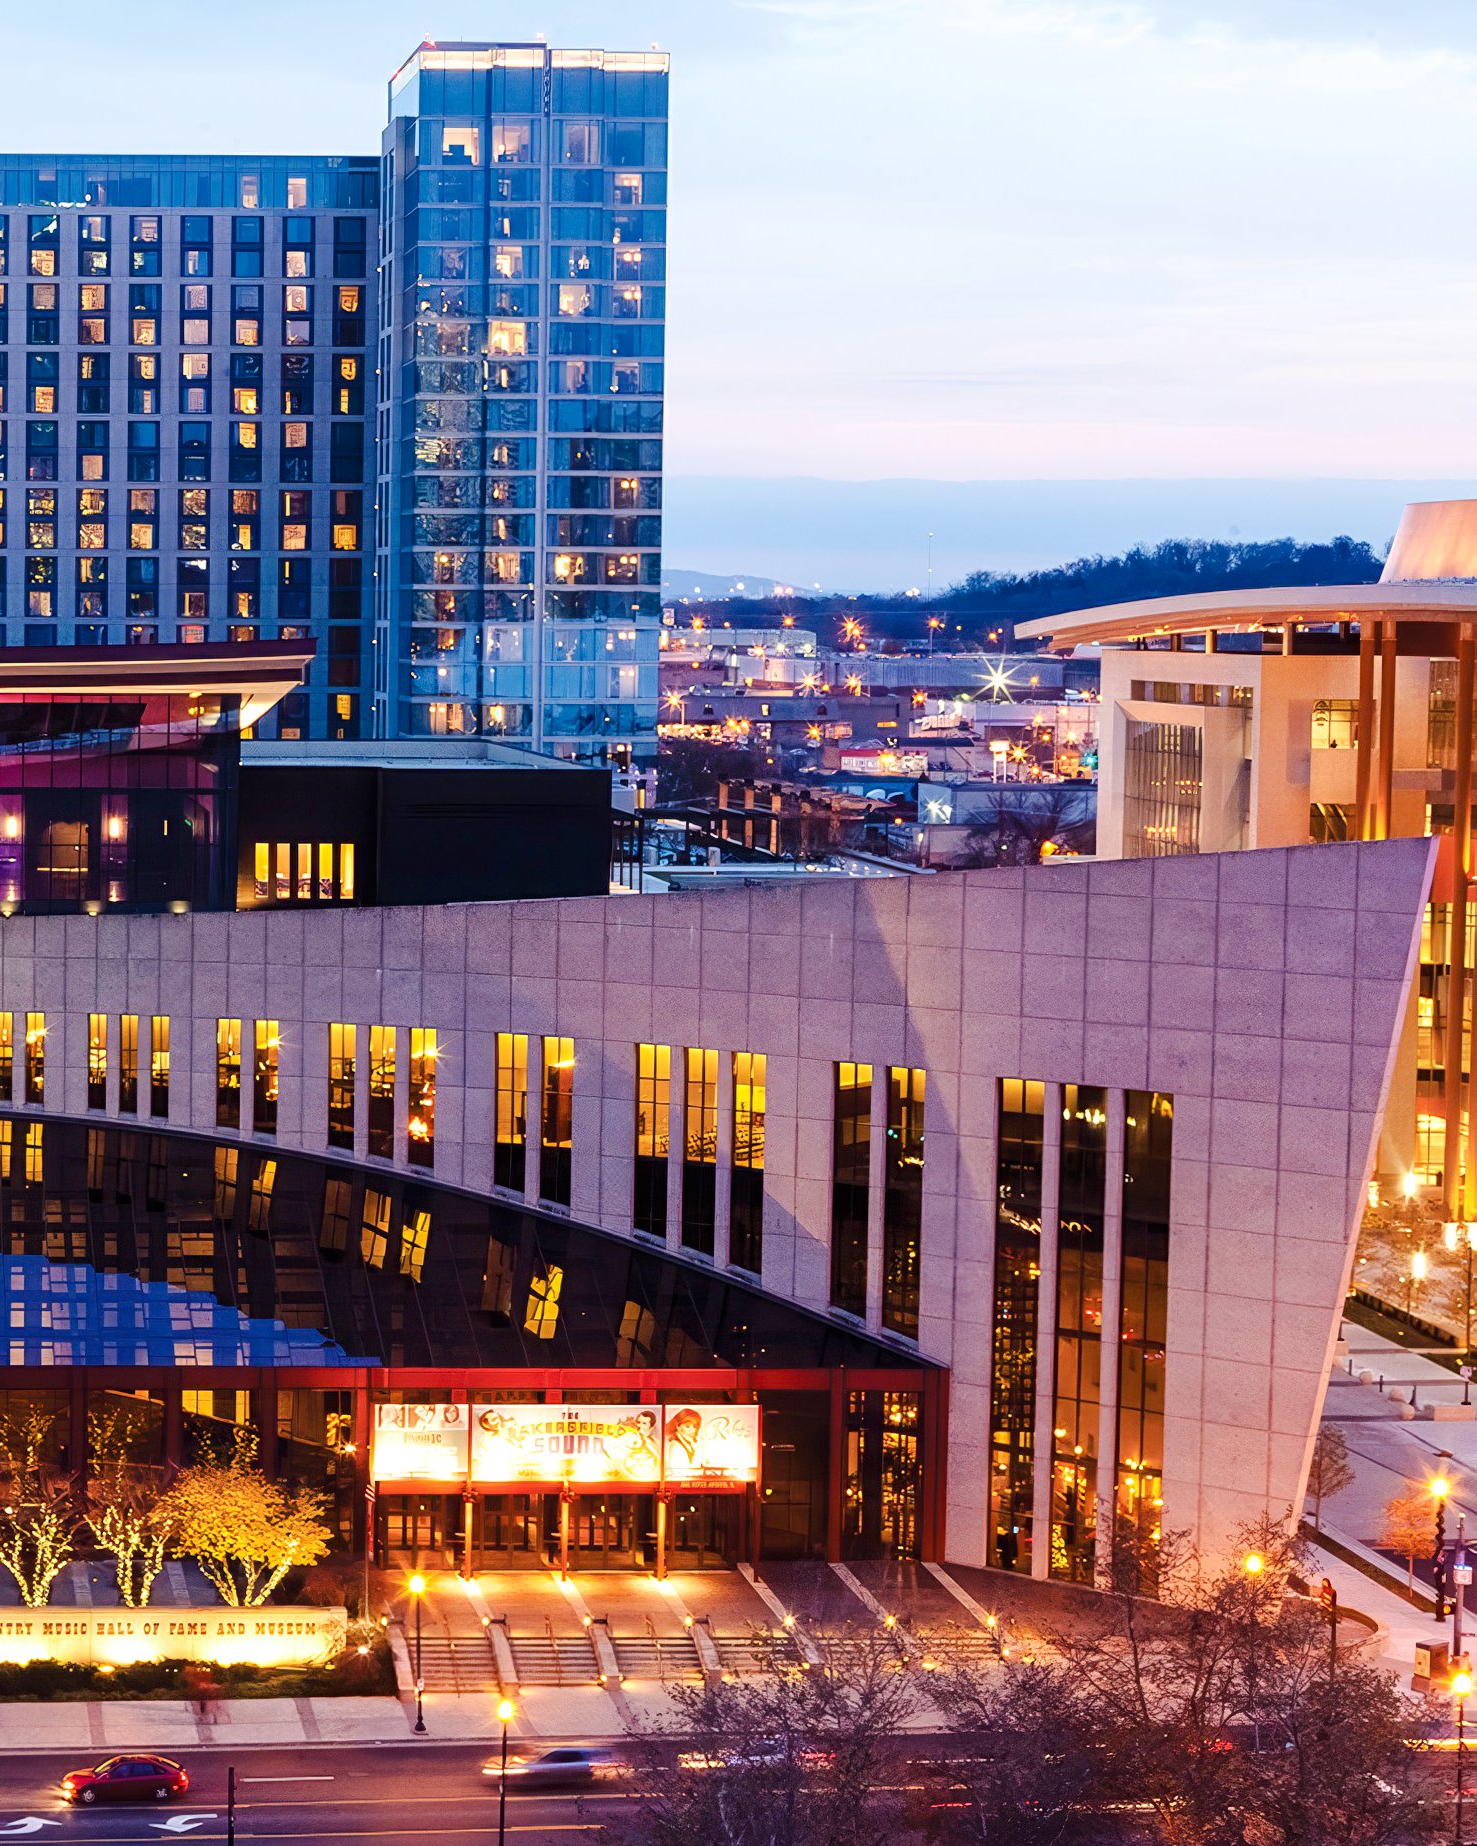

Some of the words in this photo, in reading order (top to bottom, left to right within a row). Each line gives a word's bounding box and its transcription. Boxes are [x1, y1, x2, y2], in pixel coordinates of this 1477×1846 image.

[42, 1622, 87, 1635] MUSIC
[96, 1622, 134, 1635] HALL
[143, 1622, 160, 1635] OF
[169, 1622, 207, 1635] FAME
[217, 1622, 245, 1635] AND
[255, 1622, 316, 1635] MUSEUM
